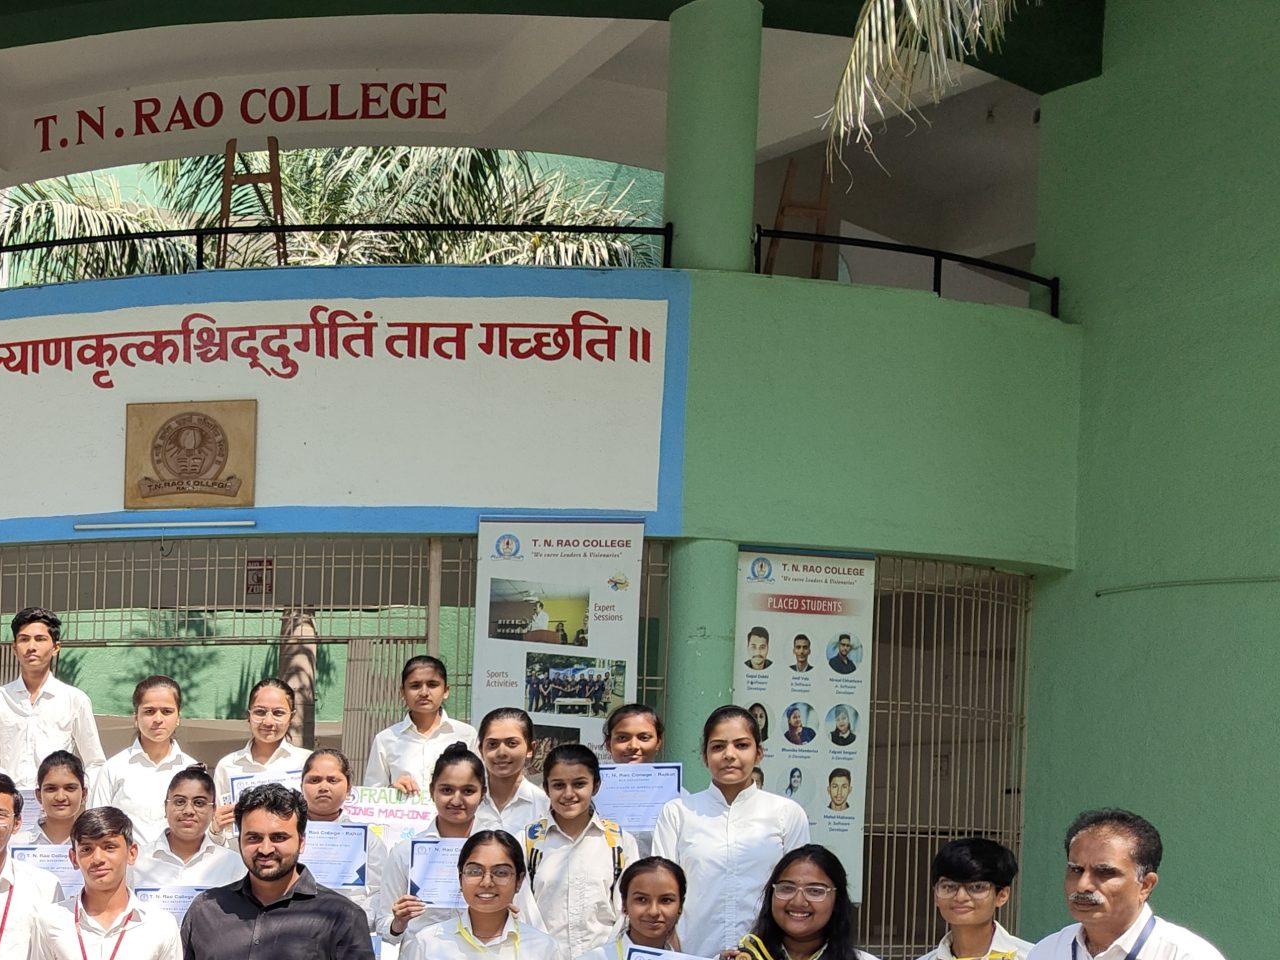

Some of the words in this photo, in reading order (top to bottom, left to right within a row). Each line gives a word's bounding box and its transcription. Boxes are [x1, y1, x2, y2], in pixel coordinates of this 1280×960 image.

[240, 82, 448, 127] COLLEGE
[385, 322, 473, 361] तात
[532, 539, 542, 548] T.
[543, 539, 555, 548] N.
[556, 539, 580, 548] RAO
[582, 539, 633, 549] COLLEGE
[781, 563, 790, 572] T.
[791, 564, 801, 573] N.
[802, 565, 823, 574] RAO
[824, 566, 866, 577] COLLEGE
[593, 603, 616, 613] Expert
[767, 597, 799, 610] PLACED
[800, 599, 843, 613] STUDENTS
[593, 612, 624, 622] Sessions
[486, 669, 509, 679] Sports
[485, 678, 519, 688] Activities
[377, 808, 431, 821] MACHINE
